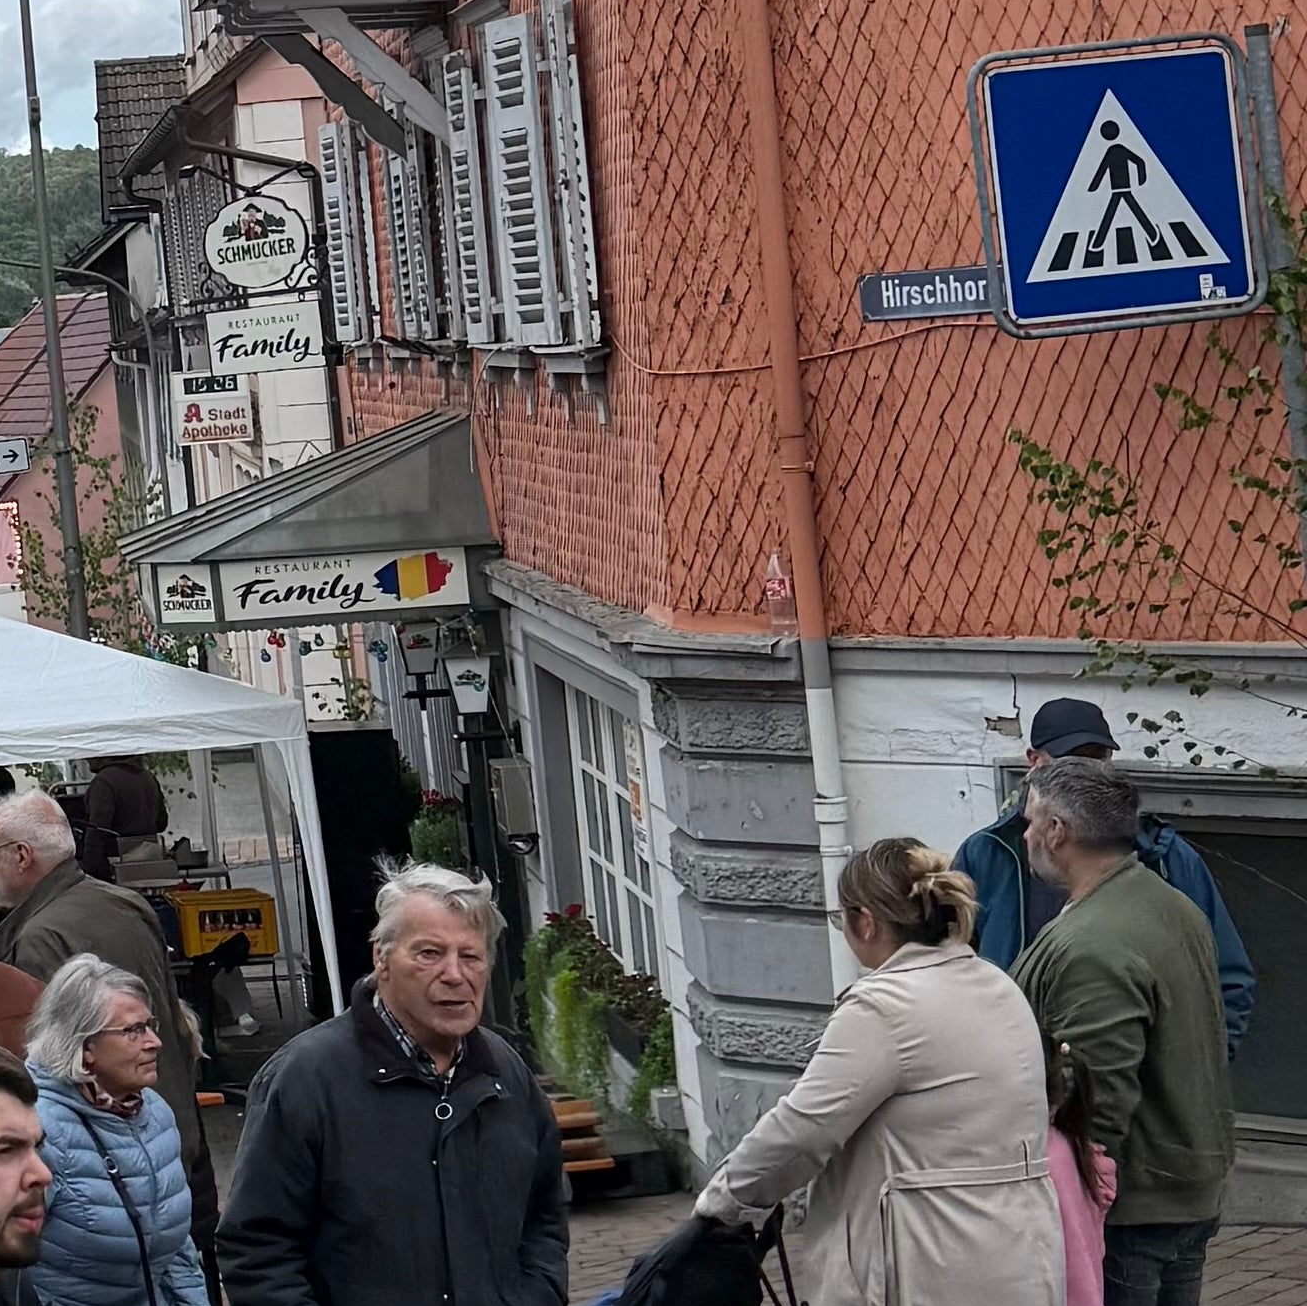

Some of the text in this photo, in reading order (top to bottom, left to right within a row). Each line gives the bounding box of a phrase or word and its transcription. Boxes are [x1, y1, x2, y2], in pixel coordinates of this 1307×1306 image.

[217, 237, 296, 265] SCHMUCKER
[881, 274, 987, 308] Hirschhor
[228, 313, 300, 329] RESTAURANT
[213, 328, 320, 363] Family
[208, 407, 246, 421] Stadt
[182, 423, 248, 439] Apotheke
[254, 558, 353, 574] RESTAURANT
[233, 573, 377, 610] Family
